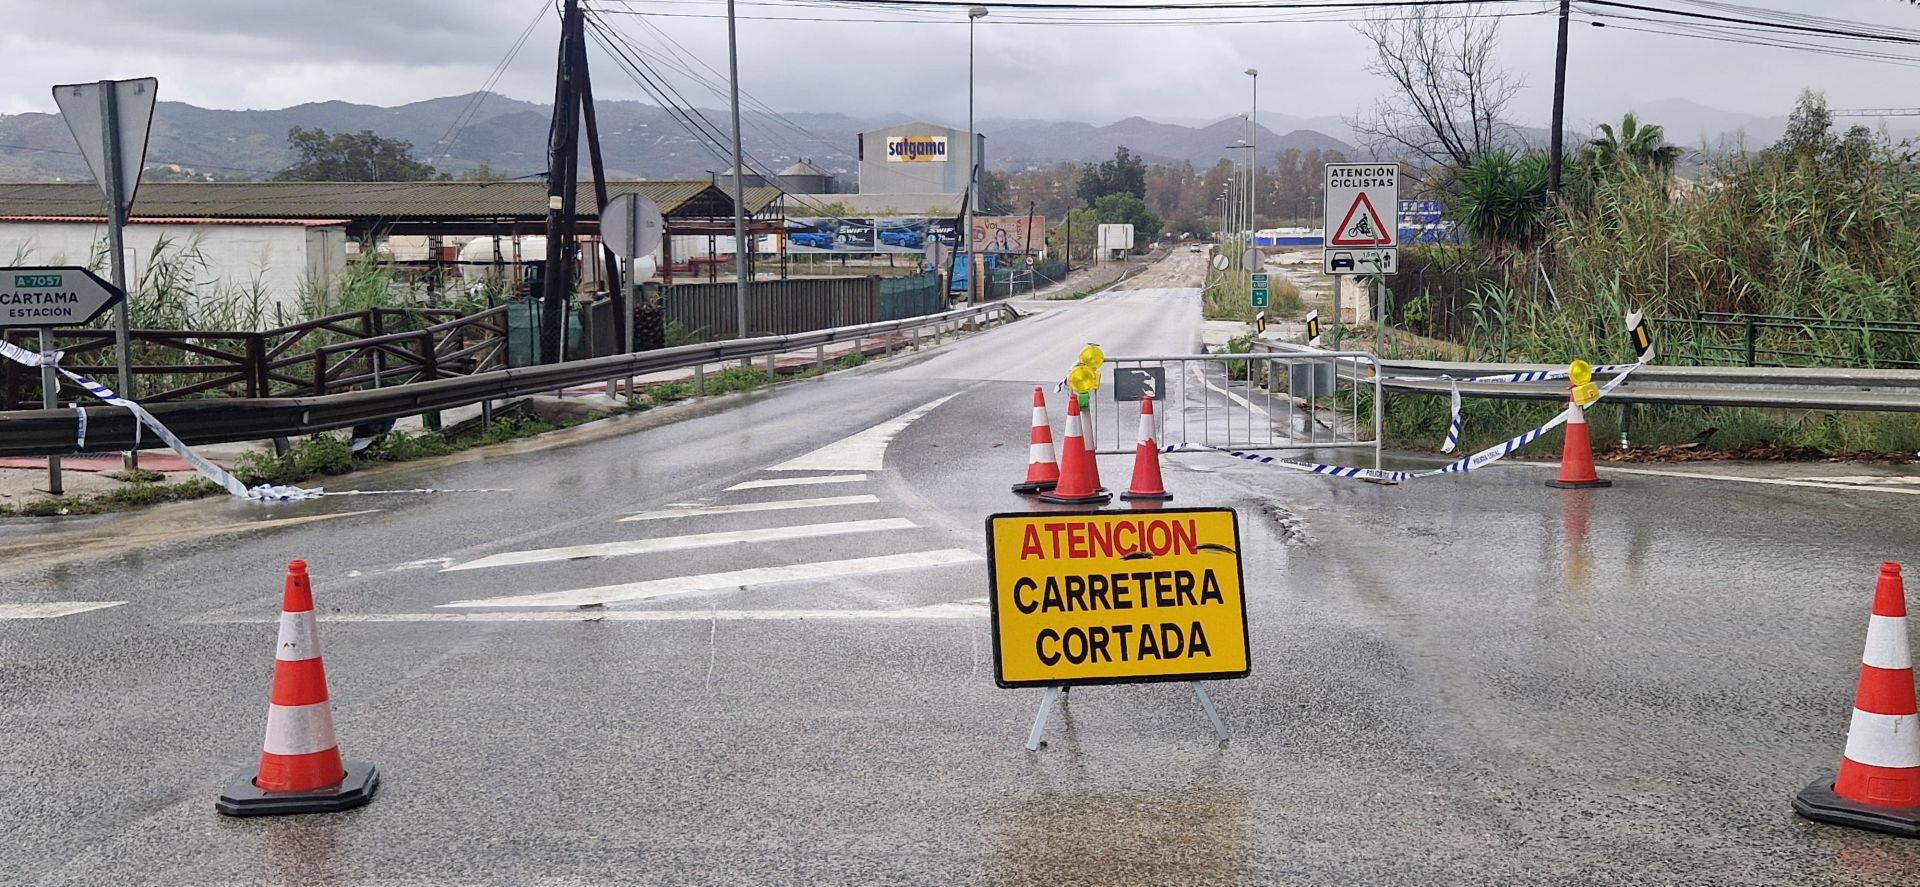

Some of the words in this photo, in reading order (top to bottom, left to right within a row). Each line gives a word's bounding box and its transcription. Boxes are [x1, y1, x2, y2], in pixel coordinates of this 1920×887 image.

[889, 138, 945, 160] satgama
[1331, 167, 1394, 177] ATENCIÓN
[1330, 179, 1394, 188] CICLISTAS
[16, 276, 61, 286] A-7057
[0, 291, 79, 305] CÁRTAMA
[1257, 297, 1263, 305] 3
[9, 306, 72, 317] ESTACIÓN
[1020, 519, 1199, 561] ATENCION
[1013, 568, 1224, 615] CARRETERA
[1035, 621, 1212, 667] CORTADA
